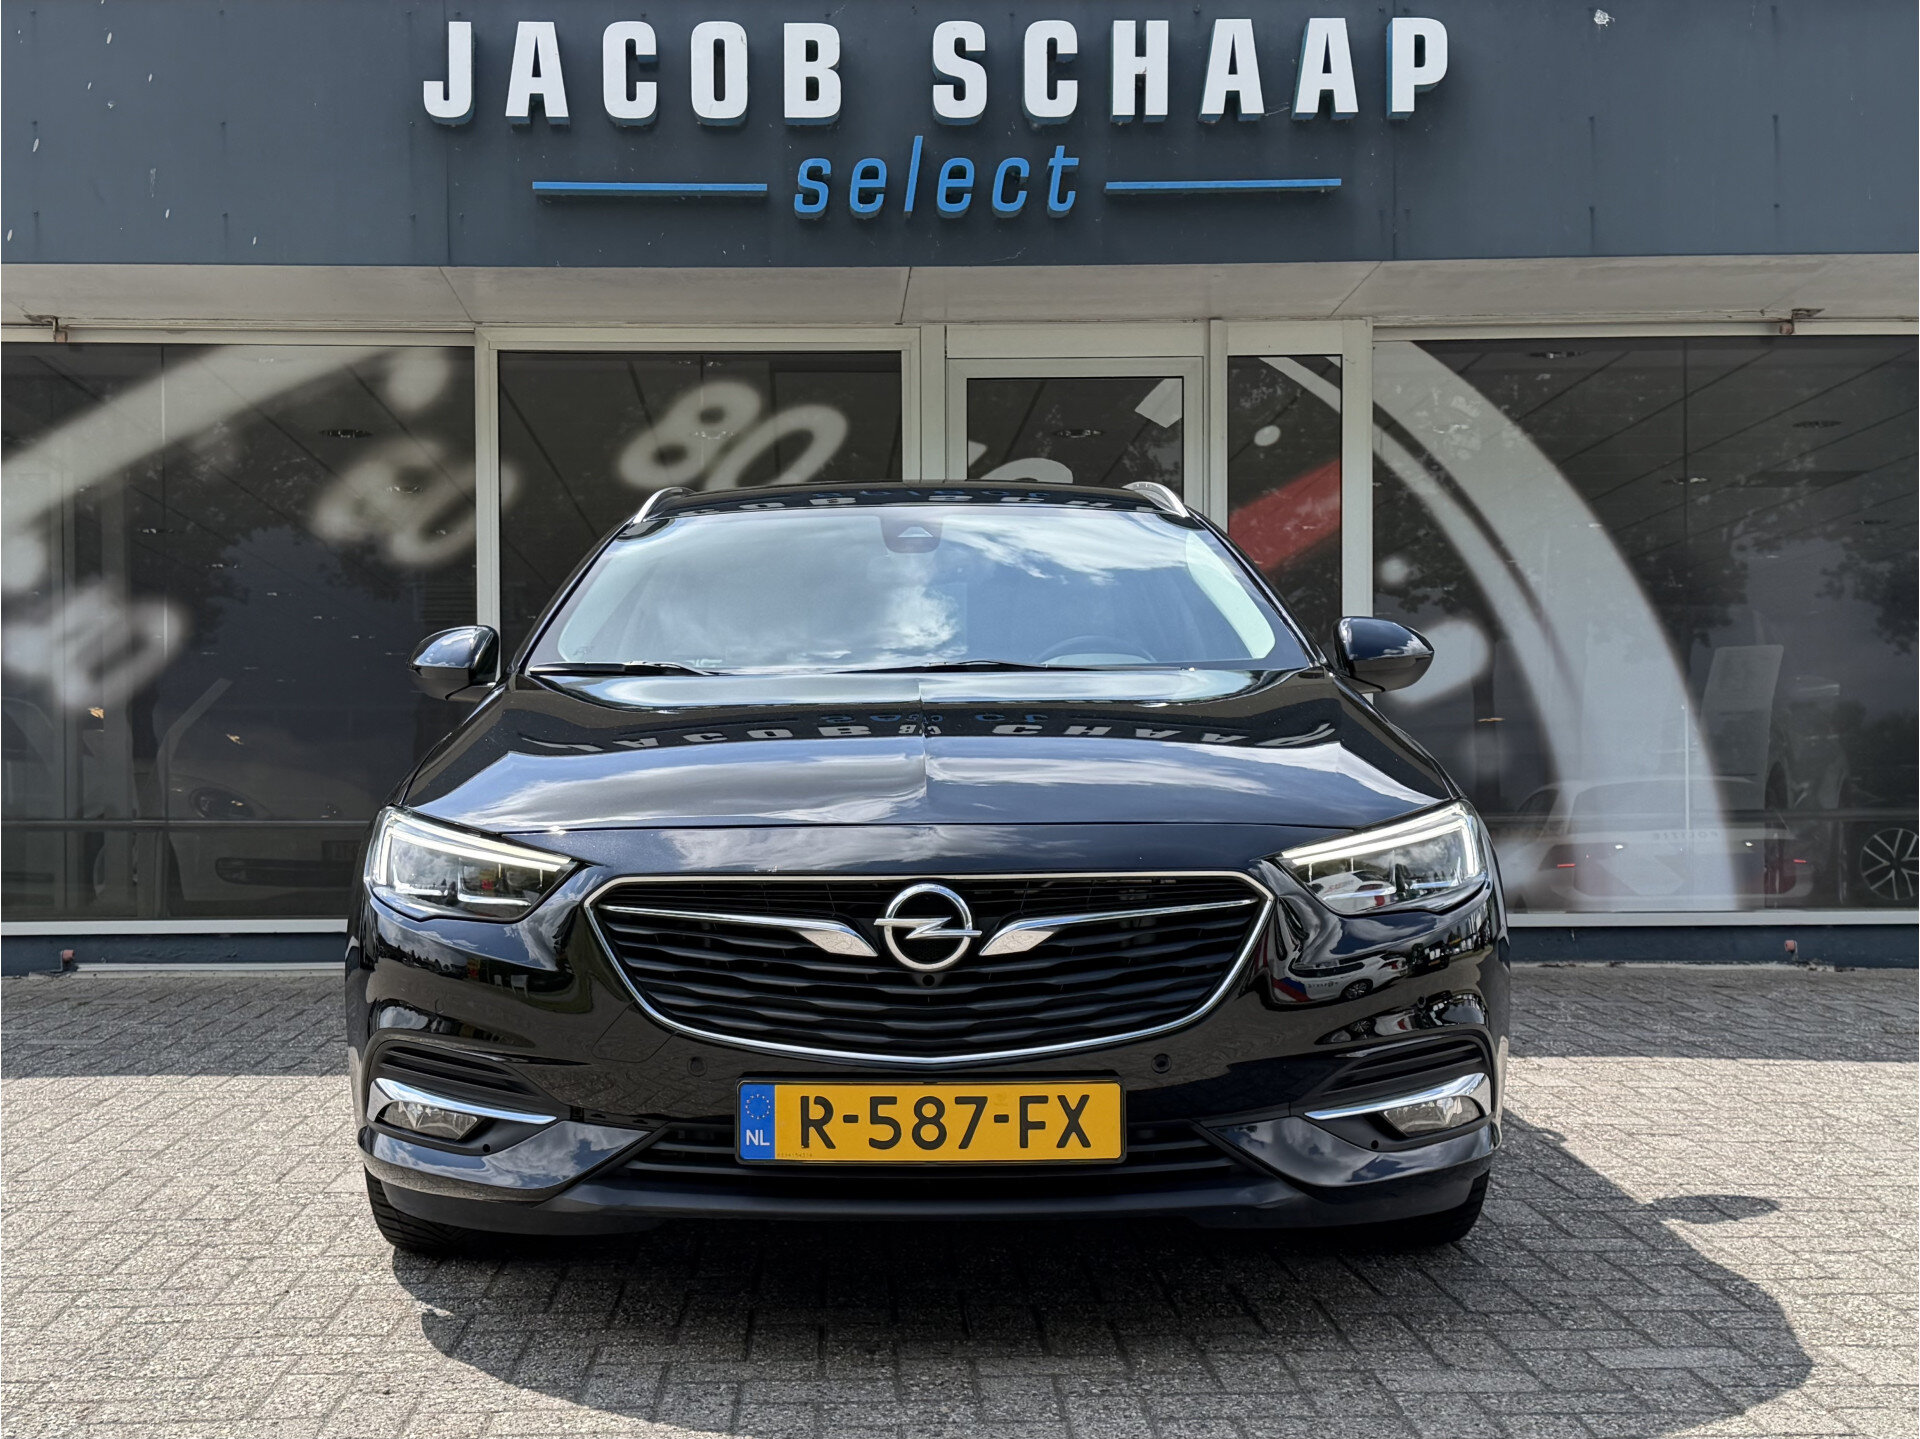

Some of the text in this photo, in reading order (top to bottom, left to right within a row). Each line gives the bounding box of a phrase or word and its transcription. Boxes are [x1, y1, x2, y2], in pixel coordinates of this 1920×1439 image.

[423, 17, 1449, 124] JACOB SCHAAP
[793, 135, 1079, 218] select
[617, 380, 848, 490] 80
[745, 1129, 770, 1146] NL
[799, 1094, 1092, 1150] R-587-FX
